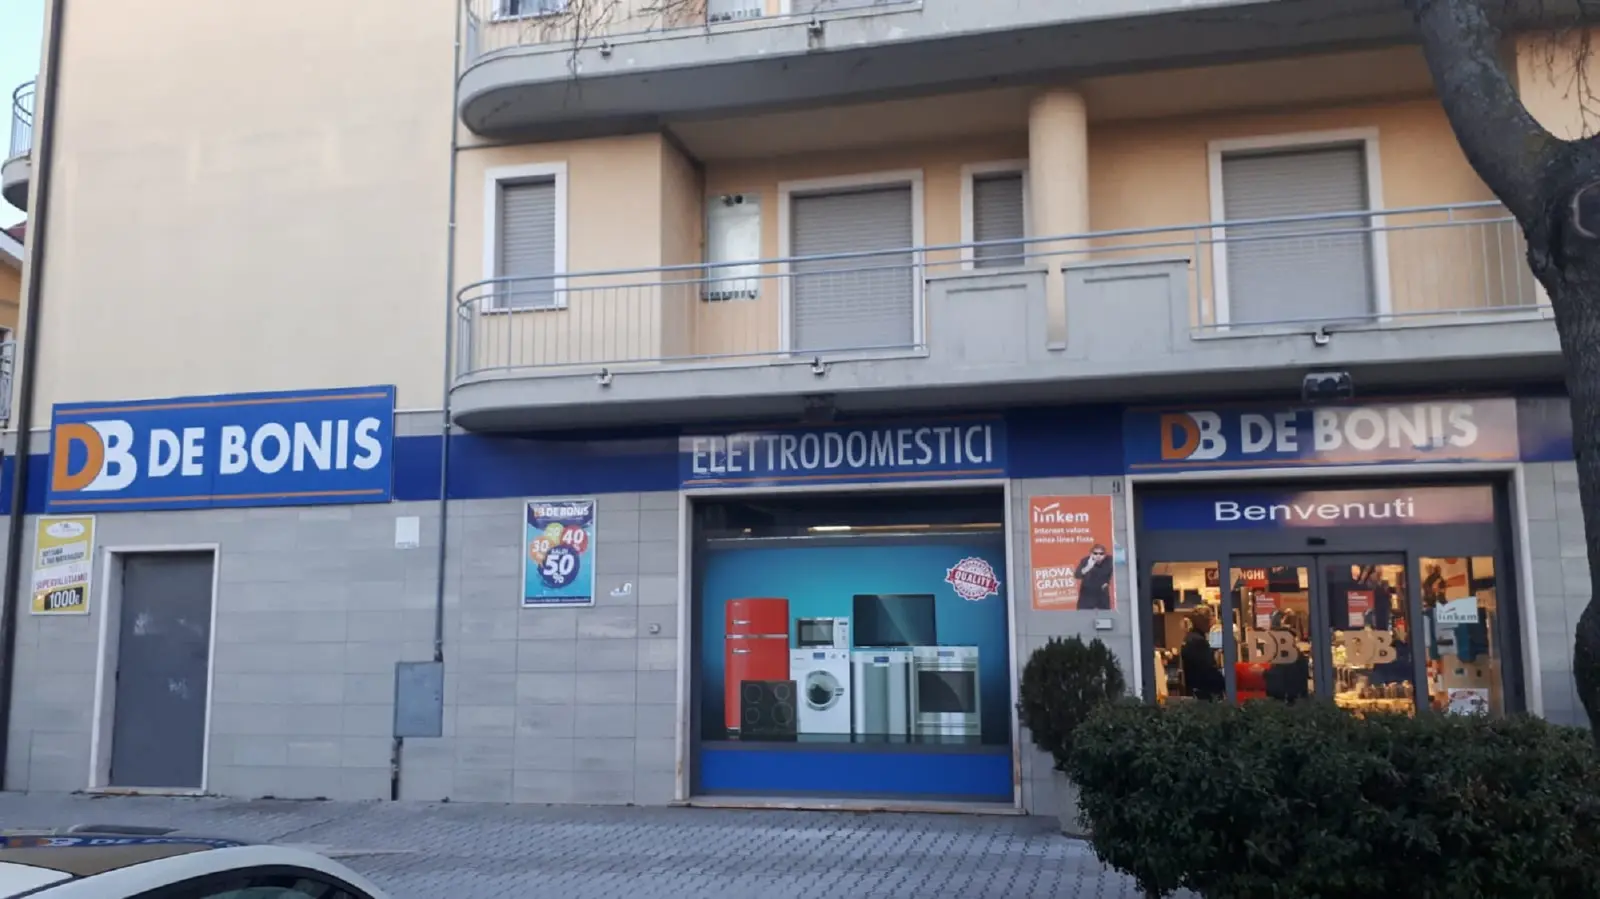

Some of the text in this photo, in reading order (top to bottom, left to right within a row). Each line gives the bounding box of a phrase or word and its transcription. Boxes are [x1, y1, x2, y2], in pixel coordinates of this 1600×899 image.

[1160, 403, 1478, 460] DB DE BONIS
[52, 417, 383, 491] DB DE BONIS
[692, 425, 993, 474] ELETTRODOMESTICI
[560, 506, 589, 517] BONIS
[1033, 502, 1089, 523] linkem
[1214, 498, 1415, 521] Benvenuti
[562, 528, 584, 545] 40
[532, 540, 549, 553] 30
[543, 554, 575, 576] 50
[1035, 567, 1074, 580] PROVA
[552, 572, 564, 584] %
[954, 570, 992, 588] QUALITY
[1036, 579, 1075, 590] GRATIS
